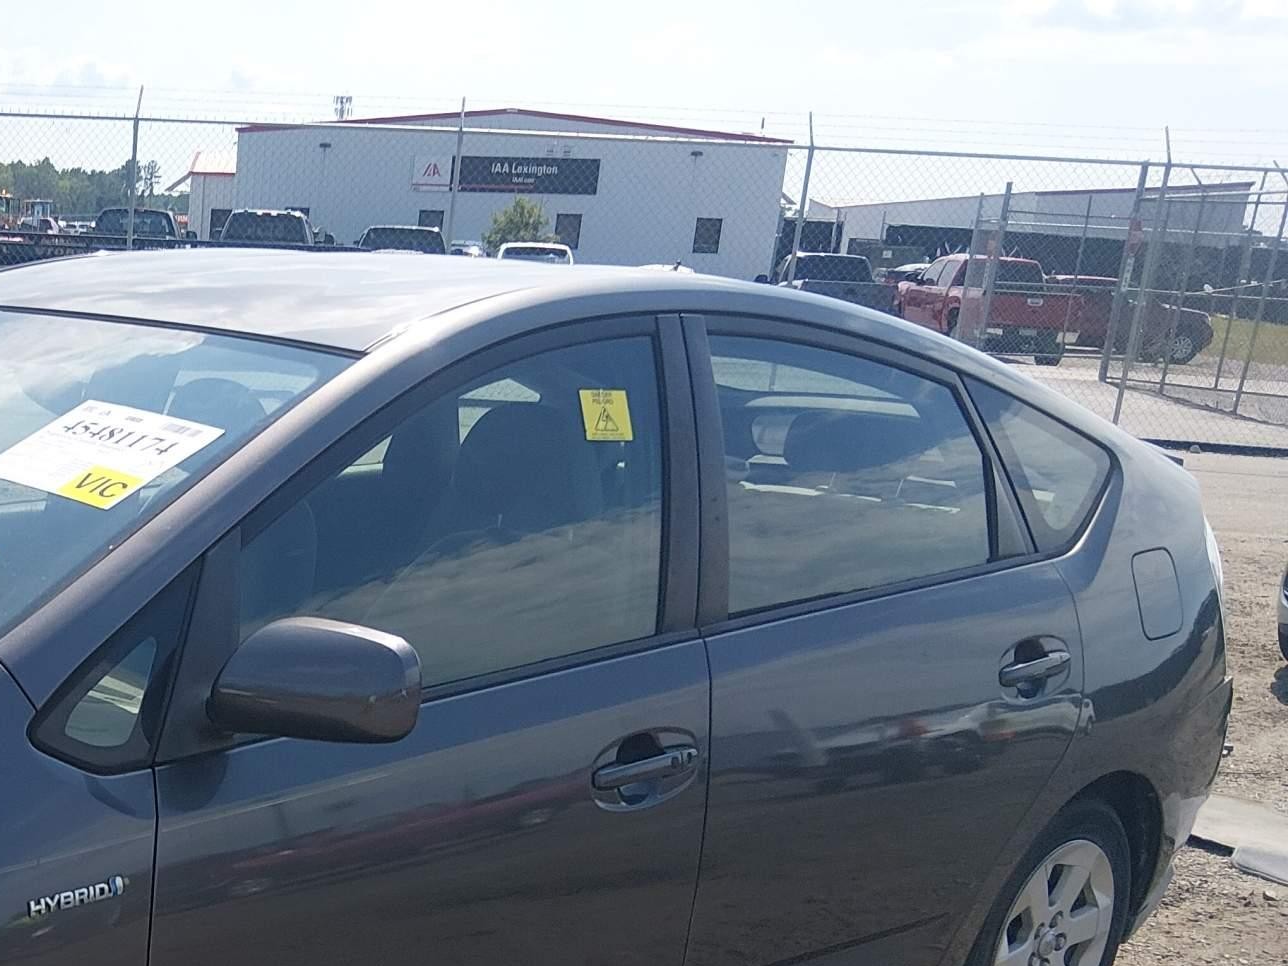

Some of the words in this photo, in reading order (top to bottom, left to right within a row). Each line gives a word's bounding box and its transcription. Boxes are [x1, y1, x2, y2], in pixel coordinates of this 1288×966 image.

[491, 162, 510, 174] IAA
[512, 162, 558, 176] Lexington
[63, 420, 179, 455] 45481174
[75, 473, 129, 498] VIC
[29, 882, 112, 917] HYBRID
